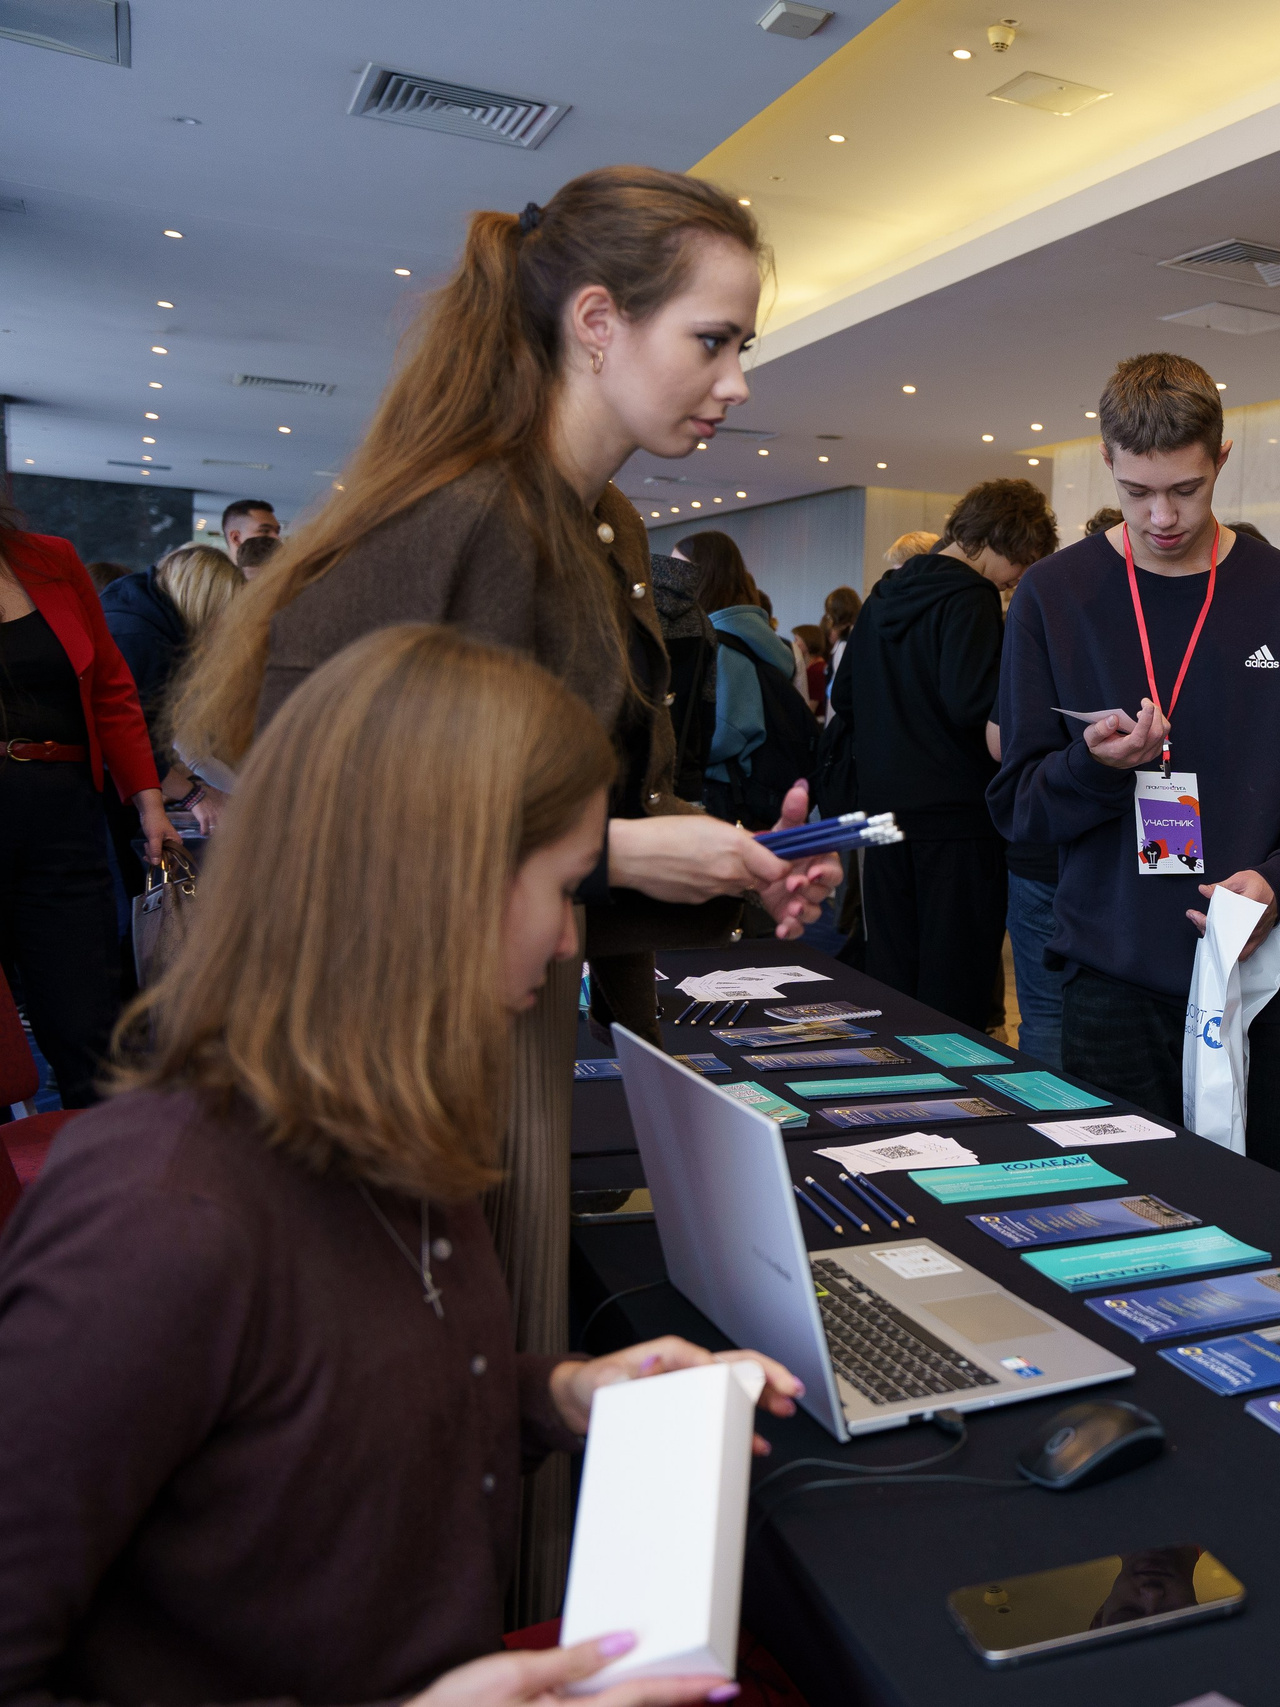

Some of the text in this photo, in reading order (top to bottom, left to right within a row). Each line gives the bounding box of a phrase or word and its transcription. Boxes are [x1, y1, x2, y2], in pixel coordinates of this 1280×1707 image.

[1244, 658, 1280, 669] adidas
[1143, 818, 1195, 828] УЧАСТНИК
[1001, 1156, 1091, 1172] КОЛЛЕДЖ
